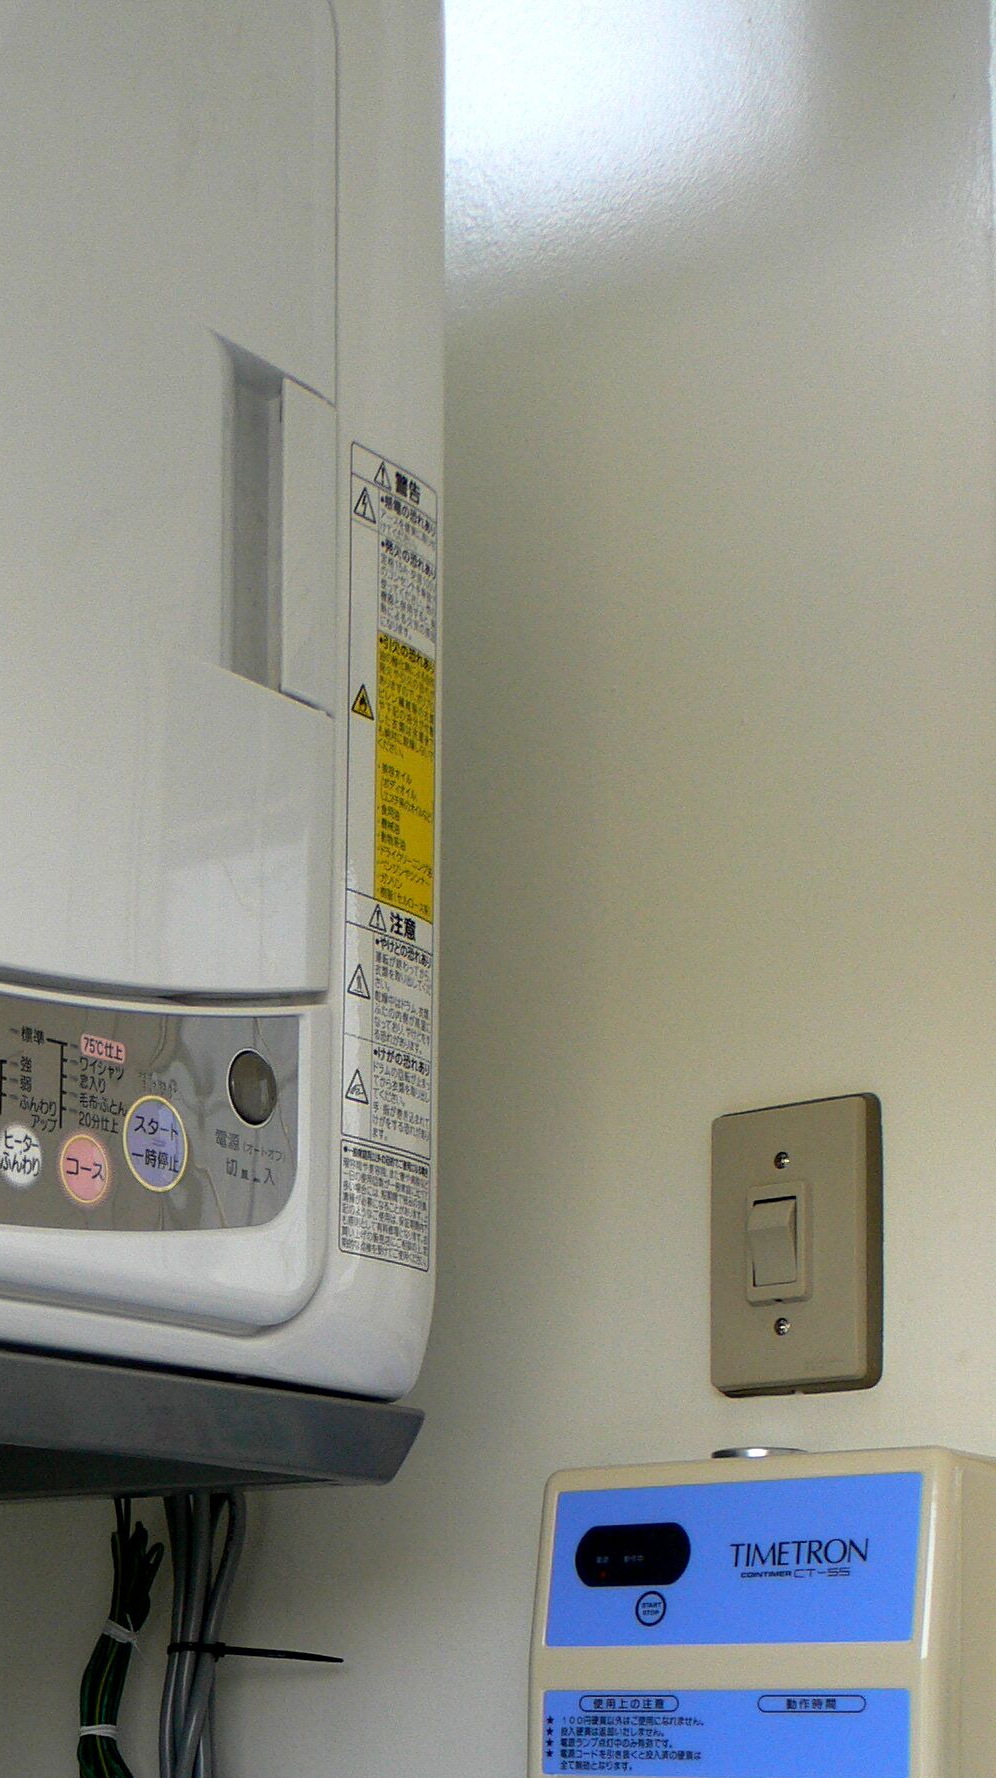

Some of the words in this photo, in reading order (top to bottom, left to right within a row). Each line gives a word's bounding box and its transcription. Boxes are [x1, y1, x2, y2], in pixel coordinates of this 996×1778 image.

[390, 911, 416, 941] 注意
[20, 1026, 45, 1045] 標準
[20, 1056, 32, 1073] 強
[79, 1056, 125, 1080] ワイシャツ
[378, 1046, 429, 1076] けがの恐れあり
[20, 1076, 32, 1092] 弱
[19, 1094, 57, 1115] ふんわり
[31, 1115, 57, 1133] アップ
[79, 1111, 119, 1134] 20分仕上
[135, 1115, 179, 1141] スタート
[4, 1129, 39, 1152] ヒーター
[215, 1128, 239, 1151] 電源
[0, 1153, 40, 1176] ふんわり
[66, 1157, 104, 1180] コース
[132, 1148, 179, 1173] 一時停止
[264, 1167, 275, 1186] 入
[730, 1538, 869, 1568] TIMETRON
[593, 1698, 665, 1710] 使用上の注意
[785, 1698, 837, 1710] 動作時間
